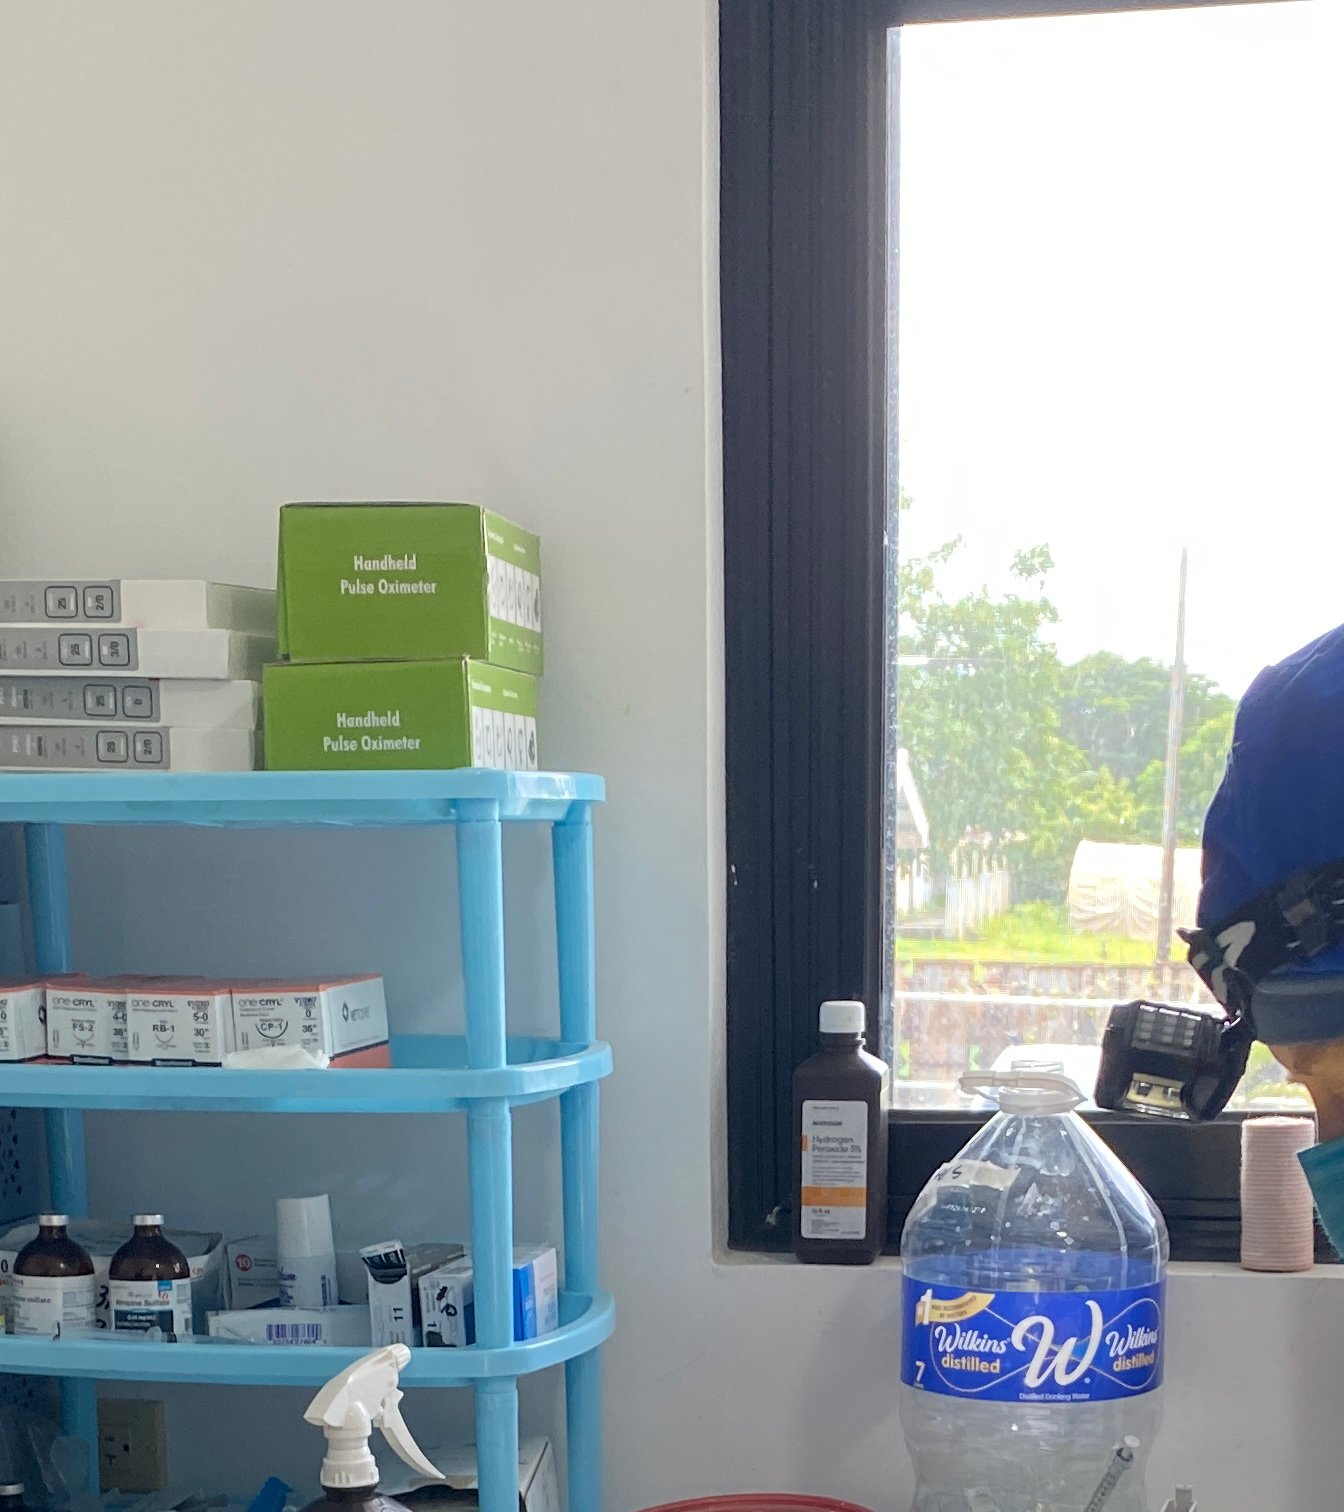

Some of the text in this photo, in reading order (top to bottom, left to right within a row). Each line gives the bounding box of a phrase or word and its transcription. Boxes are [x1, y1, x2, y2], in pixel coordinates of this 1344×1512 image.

[354, 554, 417, 571] Handheld
[340, 579, 438, 595] Pulse Oximeter
[96, 595, 105, 611] 2/0
[71, 643, 80, 656] 25
[336, 710, 401, 728] Handheld
[107, 741, 116, 753] 25
[144, 739, 152, 755] 2/0
[323, 736, 421, 752] Pulse Oximeter
[193, 1013, 208, 1021] 5-0
[153, 1024, 175, 1032] RB-1
[236, 1257, 251, 1268] 10
[934, 1323, 1008, 1354] Wilkins
[1105, 1324, 1158, 1357] Wilkins
[941, 1353, 1000, 1374] distilled
[1113, 1351, 1155, 1372] distilled
